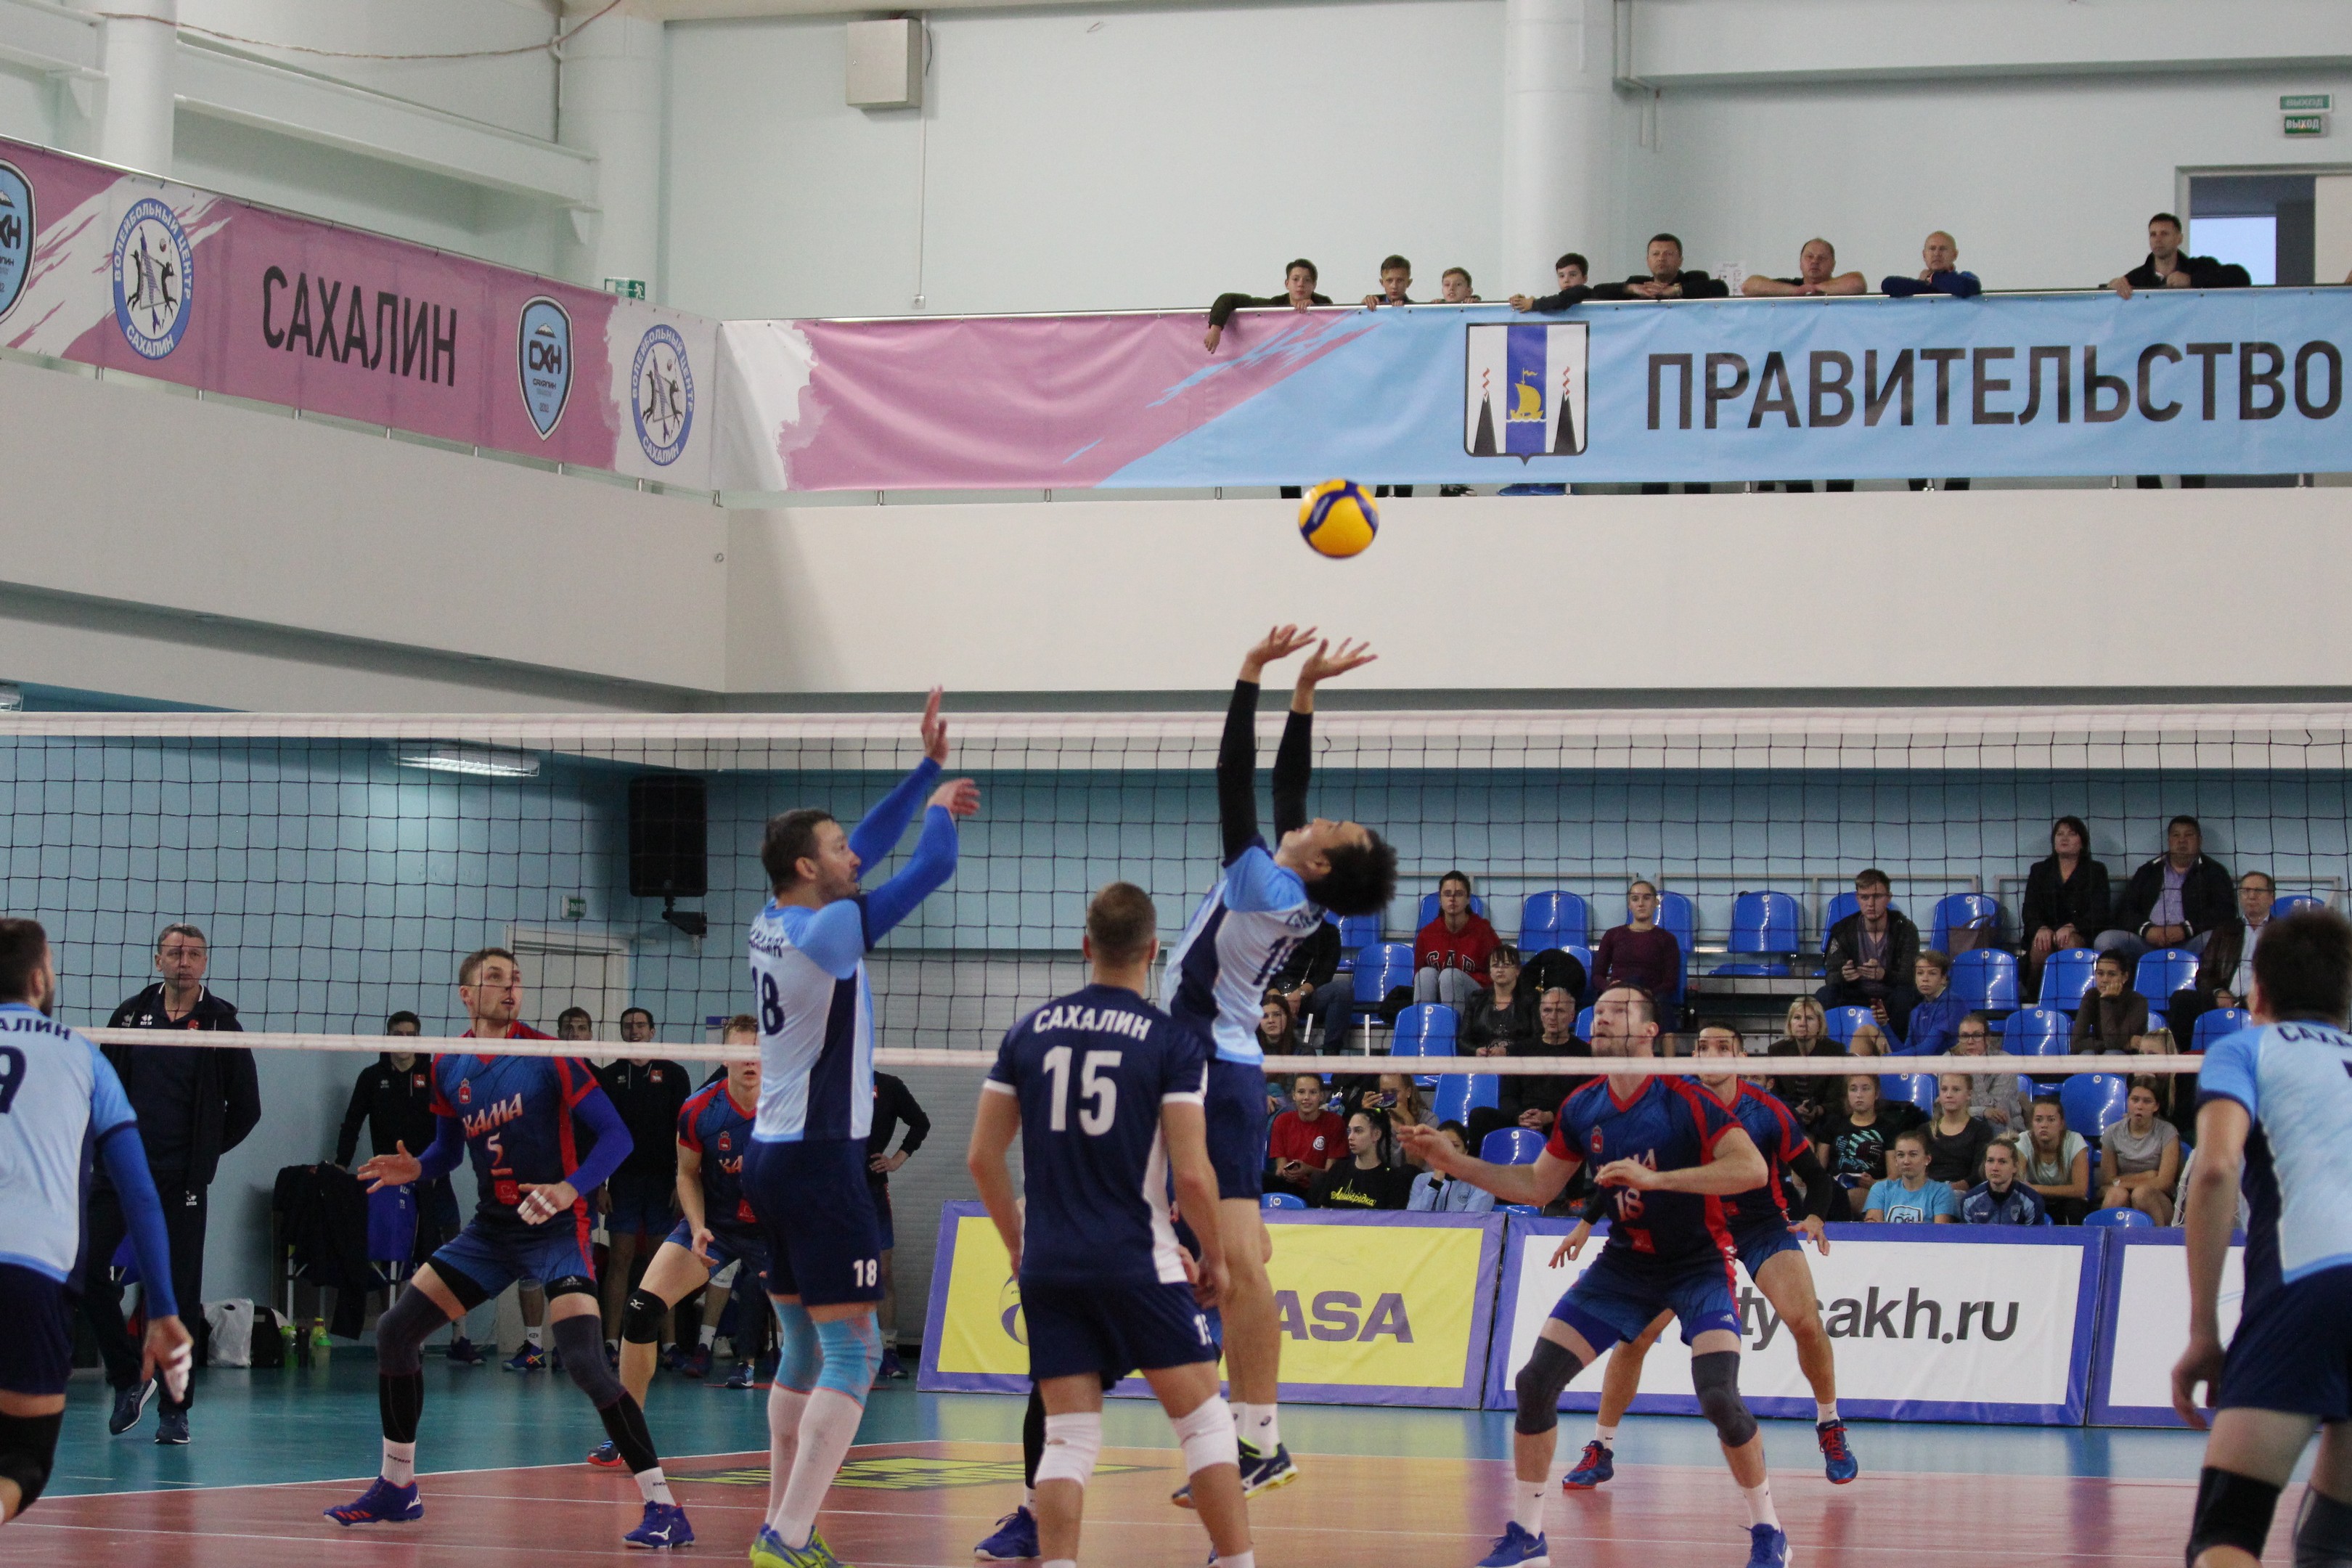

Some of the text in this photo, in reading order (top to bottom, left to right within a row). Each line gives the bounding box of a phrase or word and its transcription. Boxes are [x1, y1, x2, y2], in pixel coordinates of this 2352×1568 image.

[2285, 119, 2319, 129] ВЫХОД
[113, 203, 192, 300] ВОЛЕЙБОЛЬНЫЙ ЦЕНТР
[126, 324, 174, 356] САХАЛИН
[263, 265, 457, 387] САХАЛИН
[632, 327, 694, 412] ВОЛЕЙБОЛЬНЫЙ ЦЕНТР
[1648, 340, 2343, 430] ПРАВИТЕЛЬСТВО
[642, 437, 679, 463] САХАЛИН
[1033, 1005, 1153, 1042] САХАЛИН
[1042, 1045, 1123, 1136] 15
[462, 1093, 523, 1138] КАМА
[487, 1132, 504, 1159] 5
[1614, 1187, 1645, 1222] 18
[853, 1259, 878, 1288] 18
[1736, 1286, 2020, 1351] tyakh.ru
